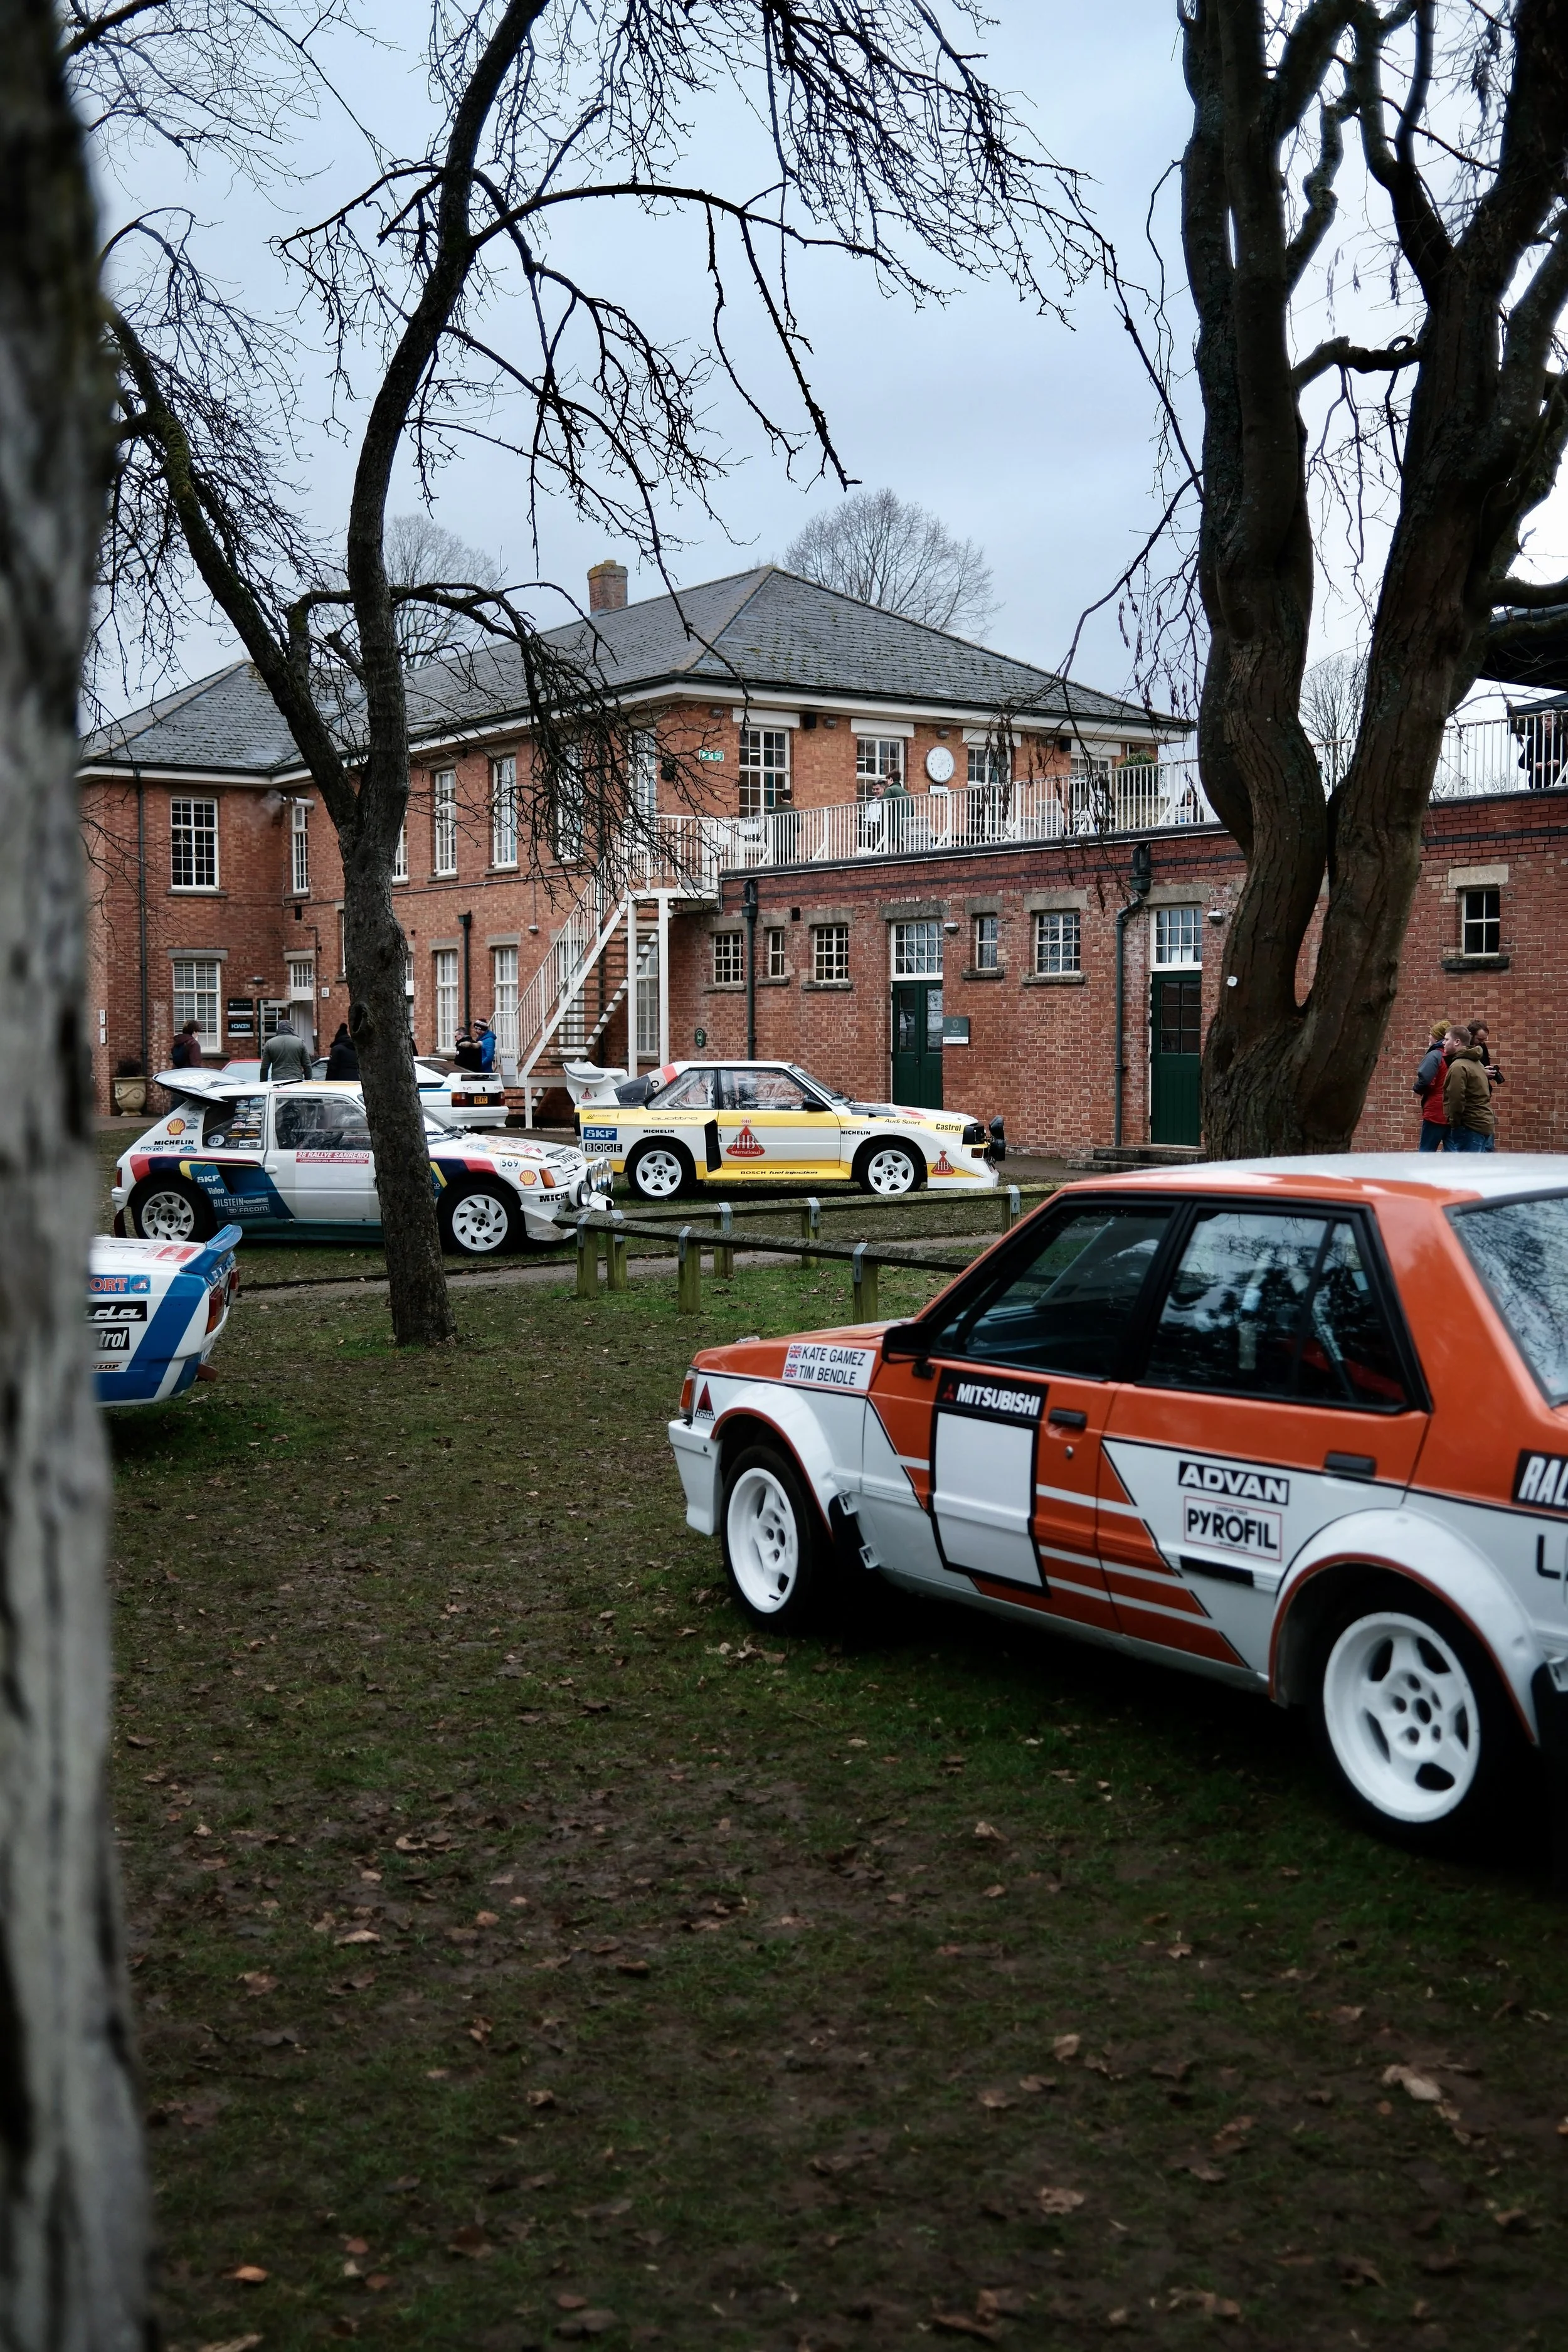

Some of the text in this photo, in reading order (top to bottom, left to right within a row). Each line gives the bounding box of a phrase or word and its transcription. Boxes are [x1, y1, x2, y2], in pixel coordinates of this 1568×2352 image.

[586, 1130, 615, 1138] SKF
[936, 1123, 961, 1131] Castrol
[586, 1143, 621, 1152] BOGE
[736, 1135, 756, 1149] HB
[551, 1150, 582, 1165] Shell
[936, 1161, 949, 1170] HB
[197, 1175, 220, 1183] SKF
[213, 1197, 244, 1207] BILSTEIN
[539, 1192, 569, 1202] MICHE
[90, 1278, 128, 1292] ORT
[98, 1330, 128, 1348] trol
[802, 1346, 866, 1366] KATE GAMEZ
[799, 1365, 857, 1385] TIM BENDLE
[956, 1382, 1041, 1416] MITSUBISHI
[696, 1411, 714, 1420] ADVAN
[1180, 1464, 1288, 1504] ADVAN
[1518, 1455, 1568, 1507] RAL
[1188, 1508, 1277, 1550] PYROFIL
